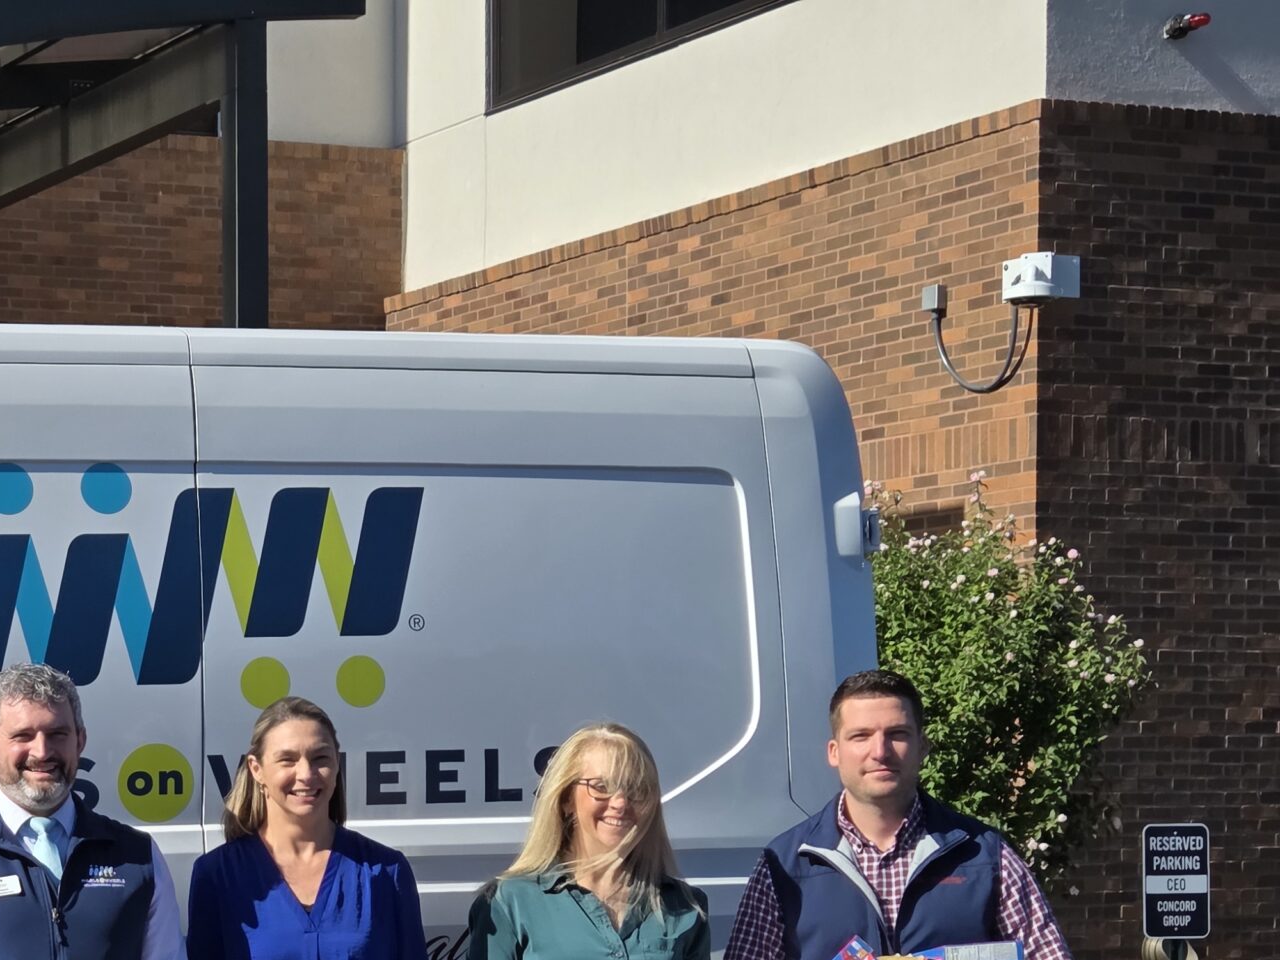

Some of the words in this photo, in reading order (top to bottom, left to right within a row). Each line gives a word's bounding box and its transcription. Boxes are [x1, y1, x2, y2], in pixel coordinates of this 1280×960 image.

[127, 769, 184, 795] on
[207, 748, 558, 806] EEL
[1149, 836, 1204, 851] RESERVED
[1153, 855, 1201, 871] PARKING
[1166, 878, 1186, 891] CEO
[1157, 900, 1197, 912] CONCORD
[1162, 915, 1191, 927] GROUP
